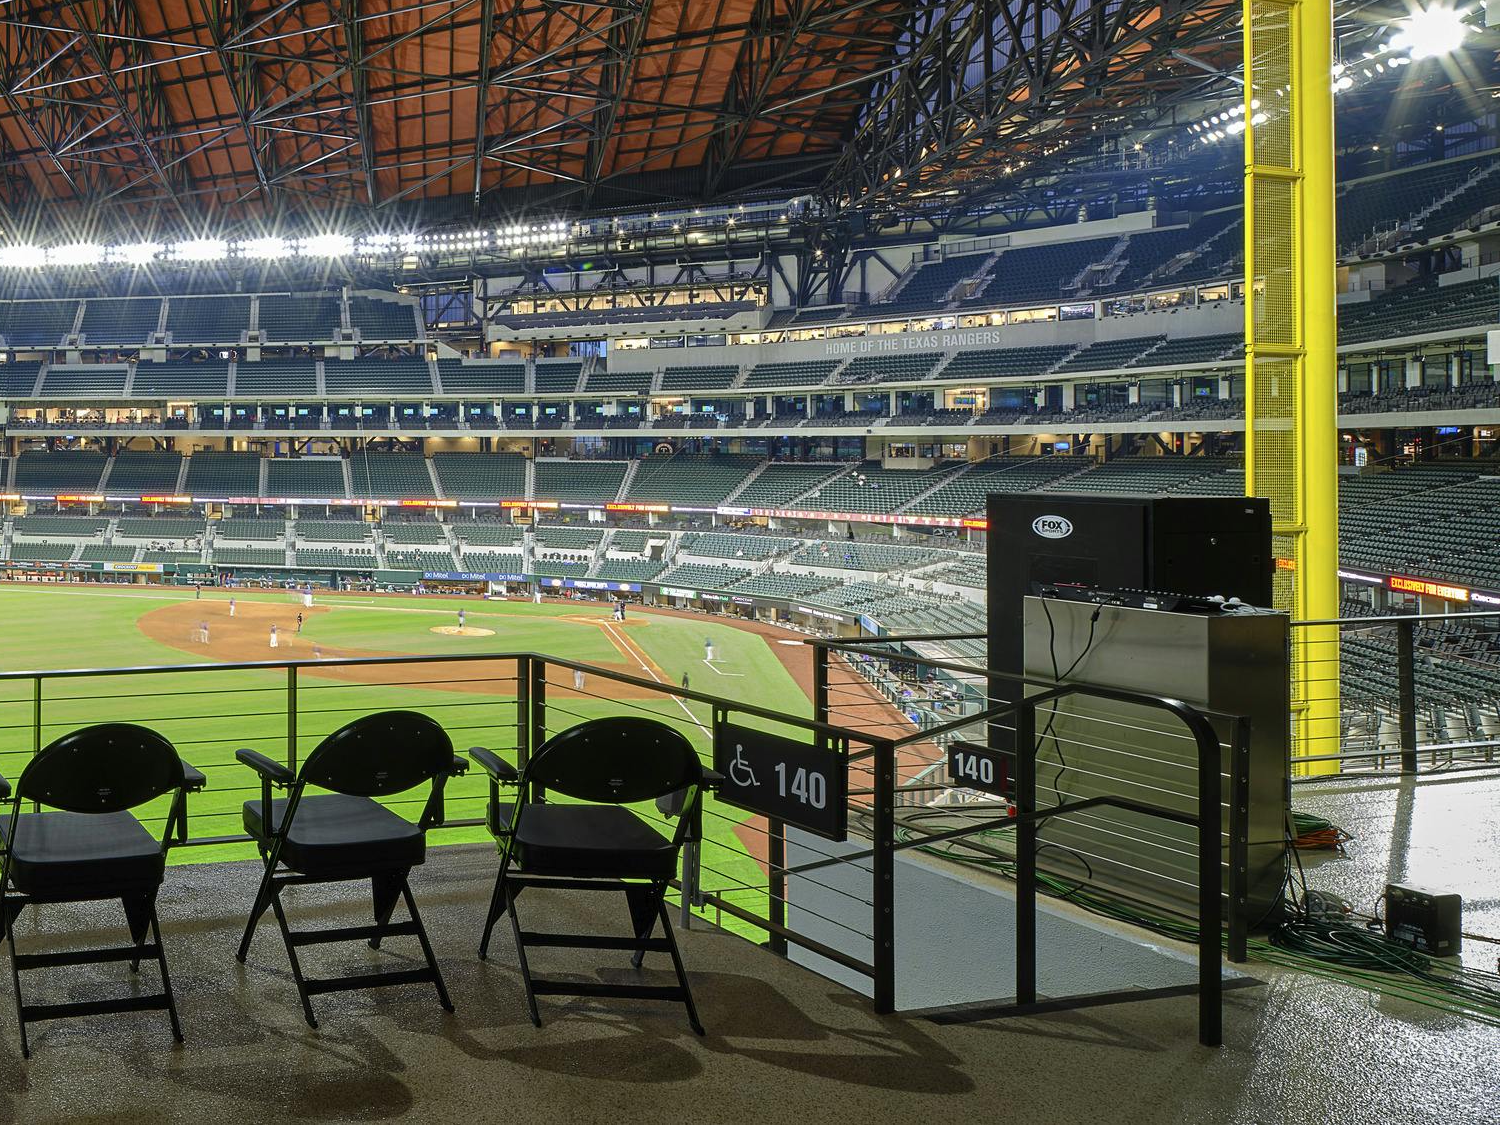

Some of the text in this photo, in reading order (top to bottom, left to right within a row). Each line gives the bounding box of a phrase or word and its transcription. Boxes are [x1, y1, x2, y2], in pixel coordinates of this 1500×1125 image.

[826, 331, 1001, 355] HOME OF THE TEXAS RANGERS
[1041, 520, 1062, 530] FOX
[1390, 577, 1424, 593] EXCLUSIVELY
[1426, 583, 1436, 594] FOR
[954, 752, 994, 784] 140
[775, 761, 827, 811] 140
